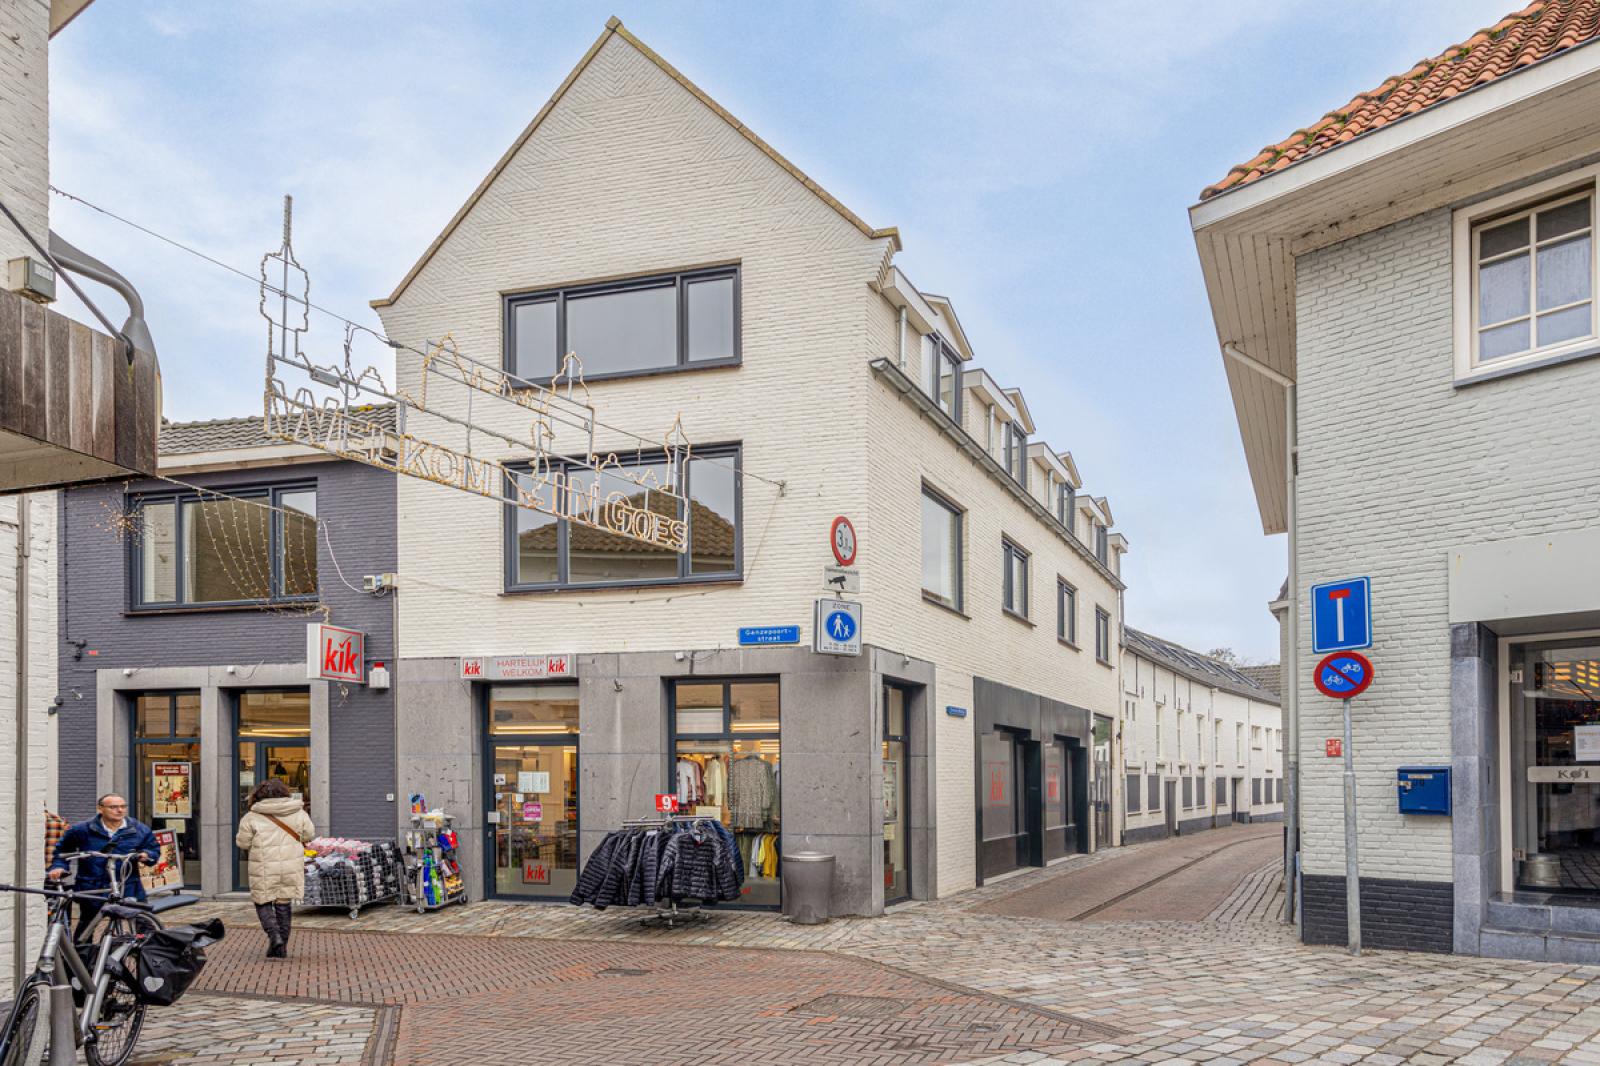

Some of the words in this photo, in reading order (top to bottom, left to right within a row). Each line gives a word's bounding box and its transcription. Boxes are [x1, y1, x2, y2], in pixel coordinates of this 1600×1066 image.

[605, 491, 689, 553] GOES
[325, 636, 358, 674] kik
[464, 661, 481, 675] kik
[502, 668, 543, 676] WELKOM
[548, 659, 565, 672] kik
[662, 795, 672, 810] 9
[526, 864, 545, 880] kik
